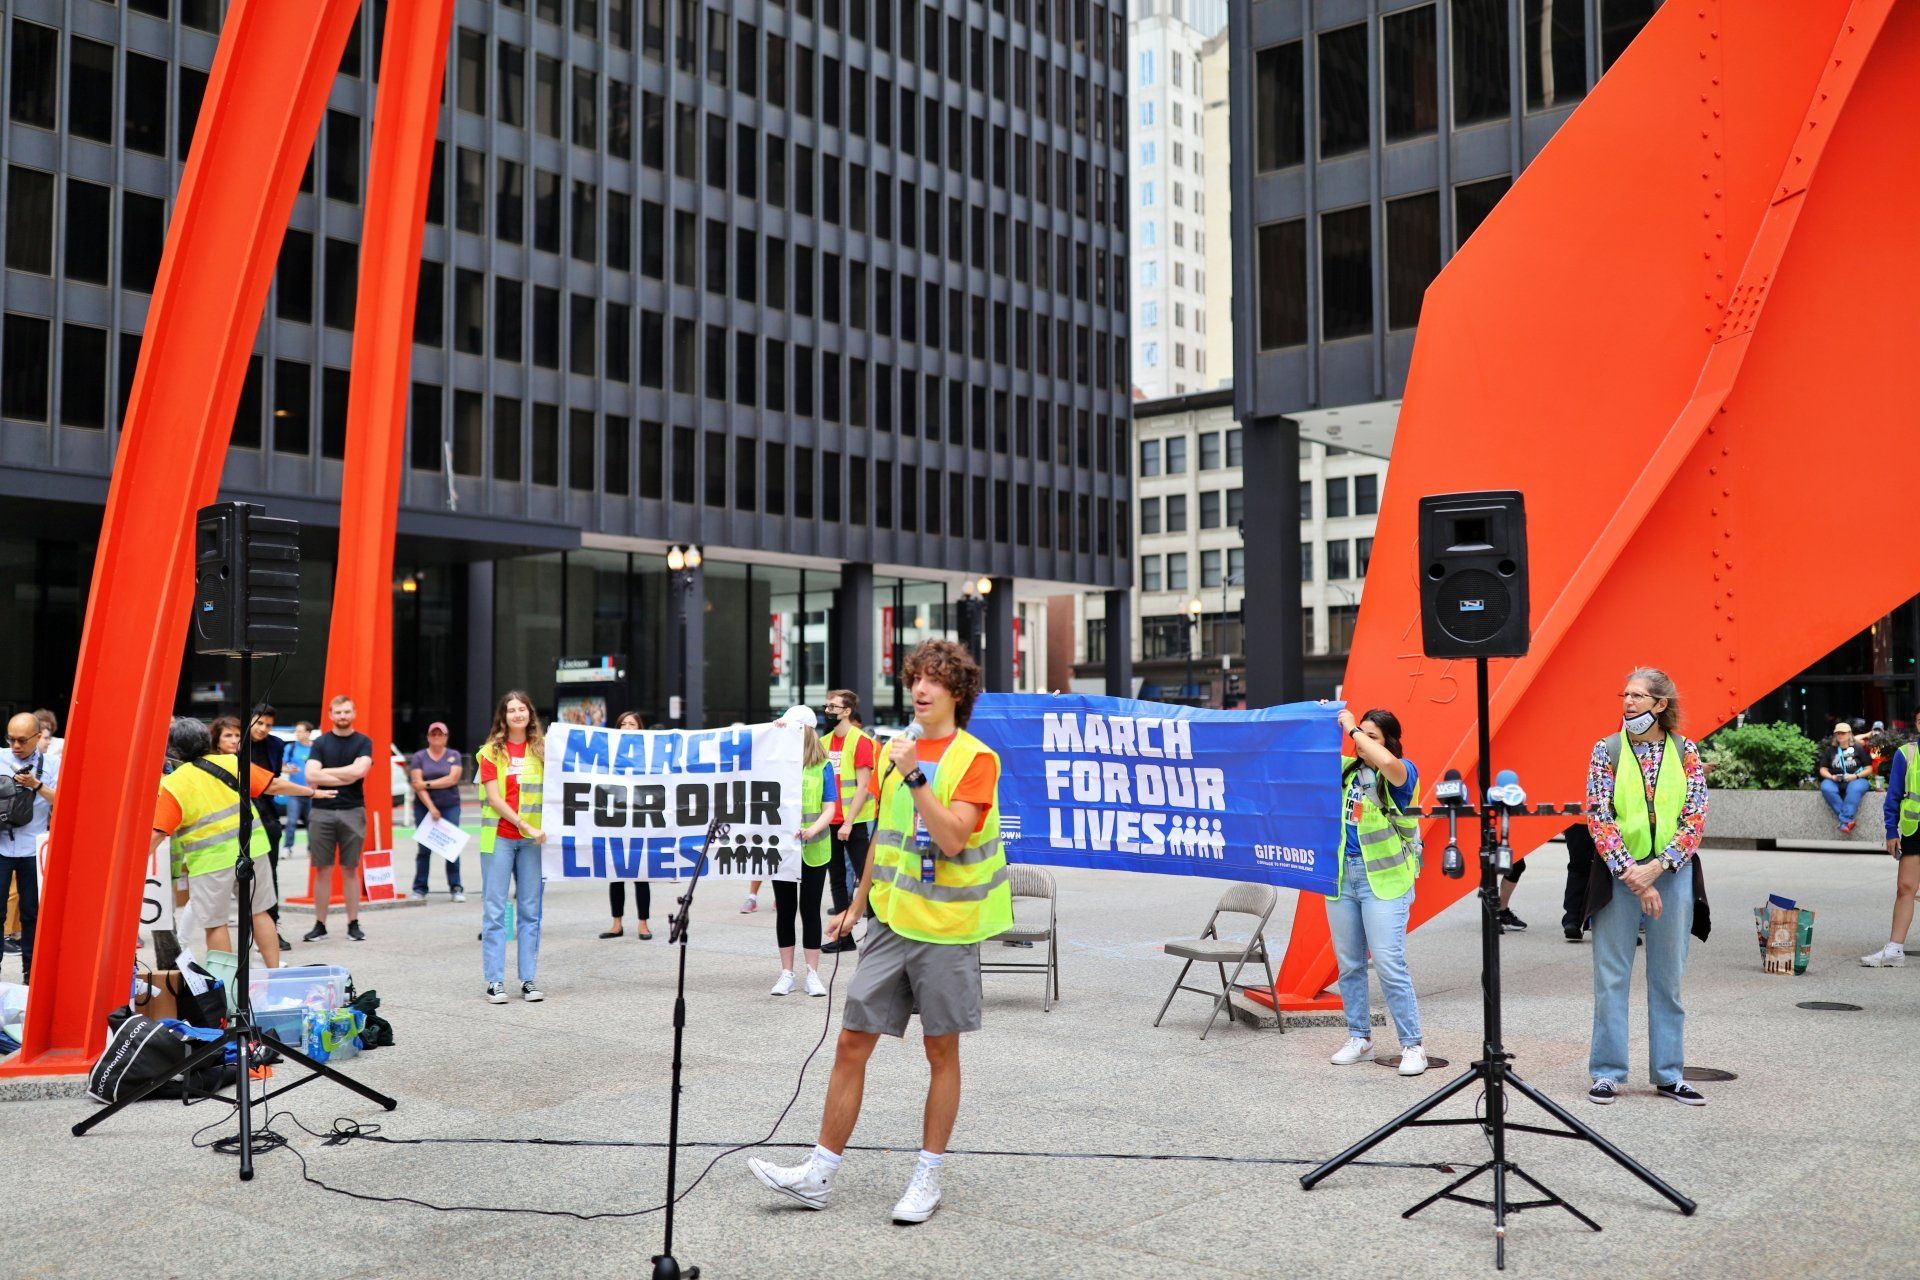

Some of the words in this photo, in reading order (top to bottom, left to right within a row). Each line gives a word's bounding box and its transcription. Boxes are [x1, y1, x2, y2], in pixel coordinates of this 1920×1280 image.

[562, 729, 752, 775] MARCH
[1043, 712, 1193, 760] MARCH
[563, 782, 667, 828] FOR
[676, 780, 782, 827] OUR
[1045, 759, 1132, 804] FOR
[1135, 764, 1226, 811] OUR
[1049, 807, 1167, 856] LIVES
[1254, 844, 1315, 865] GIFFORDS
[562, 835, 709, 879] LIVES
